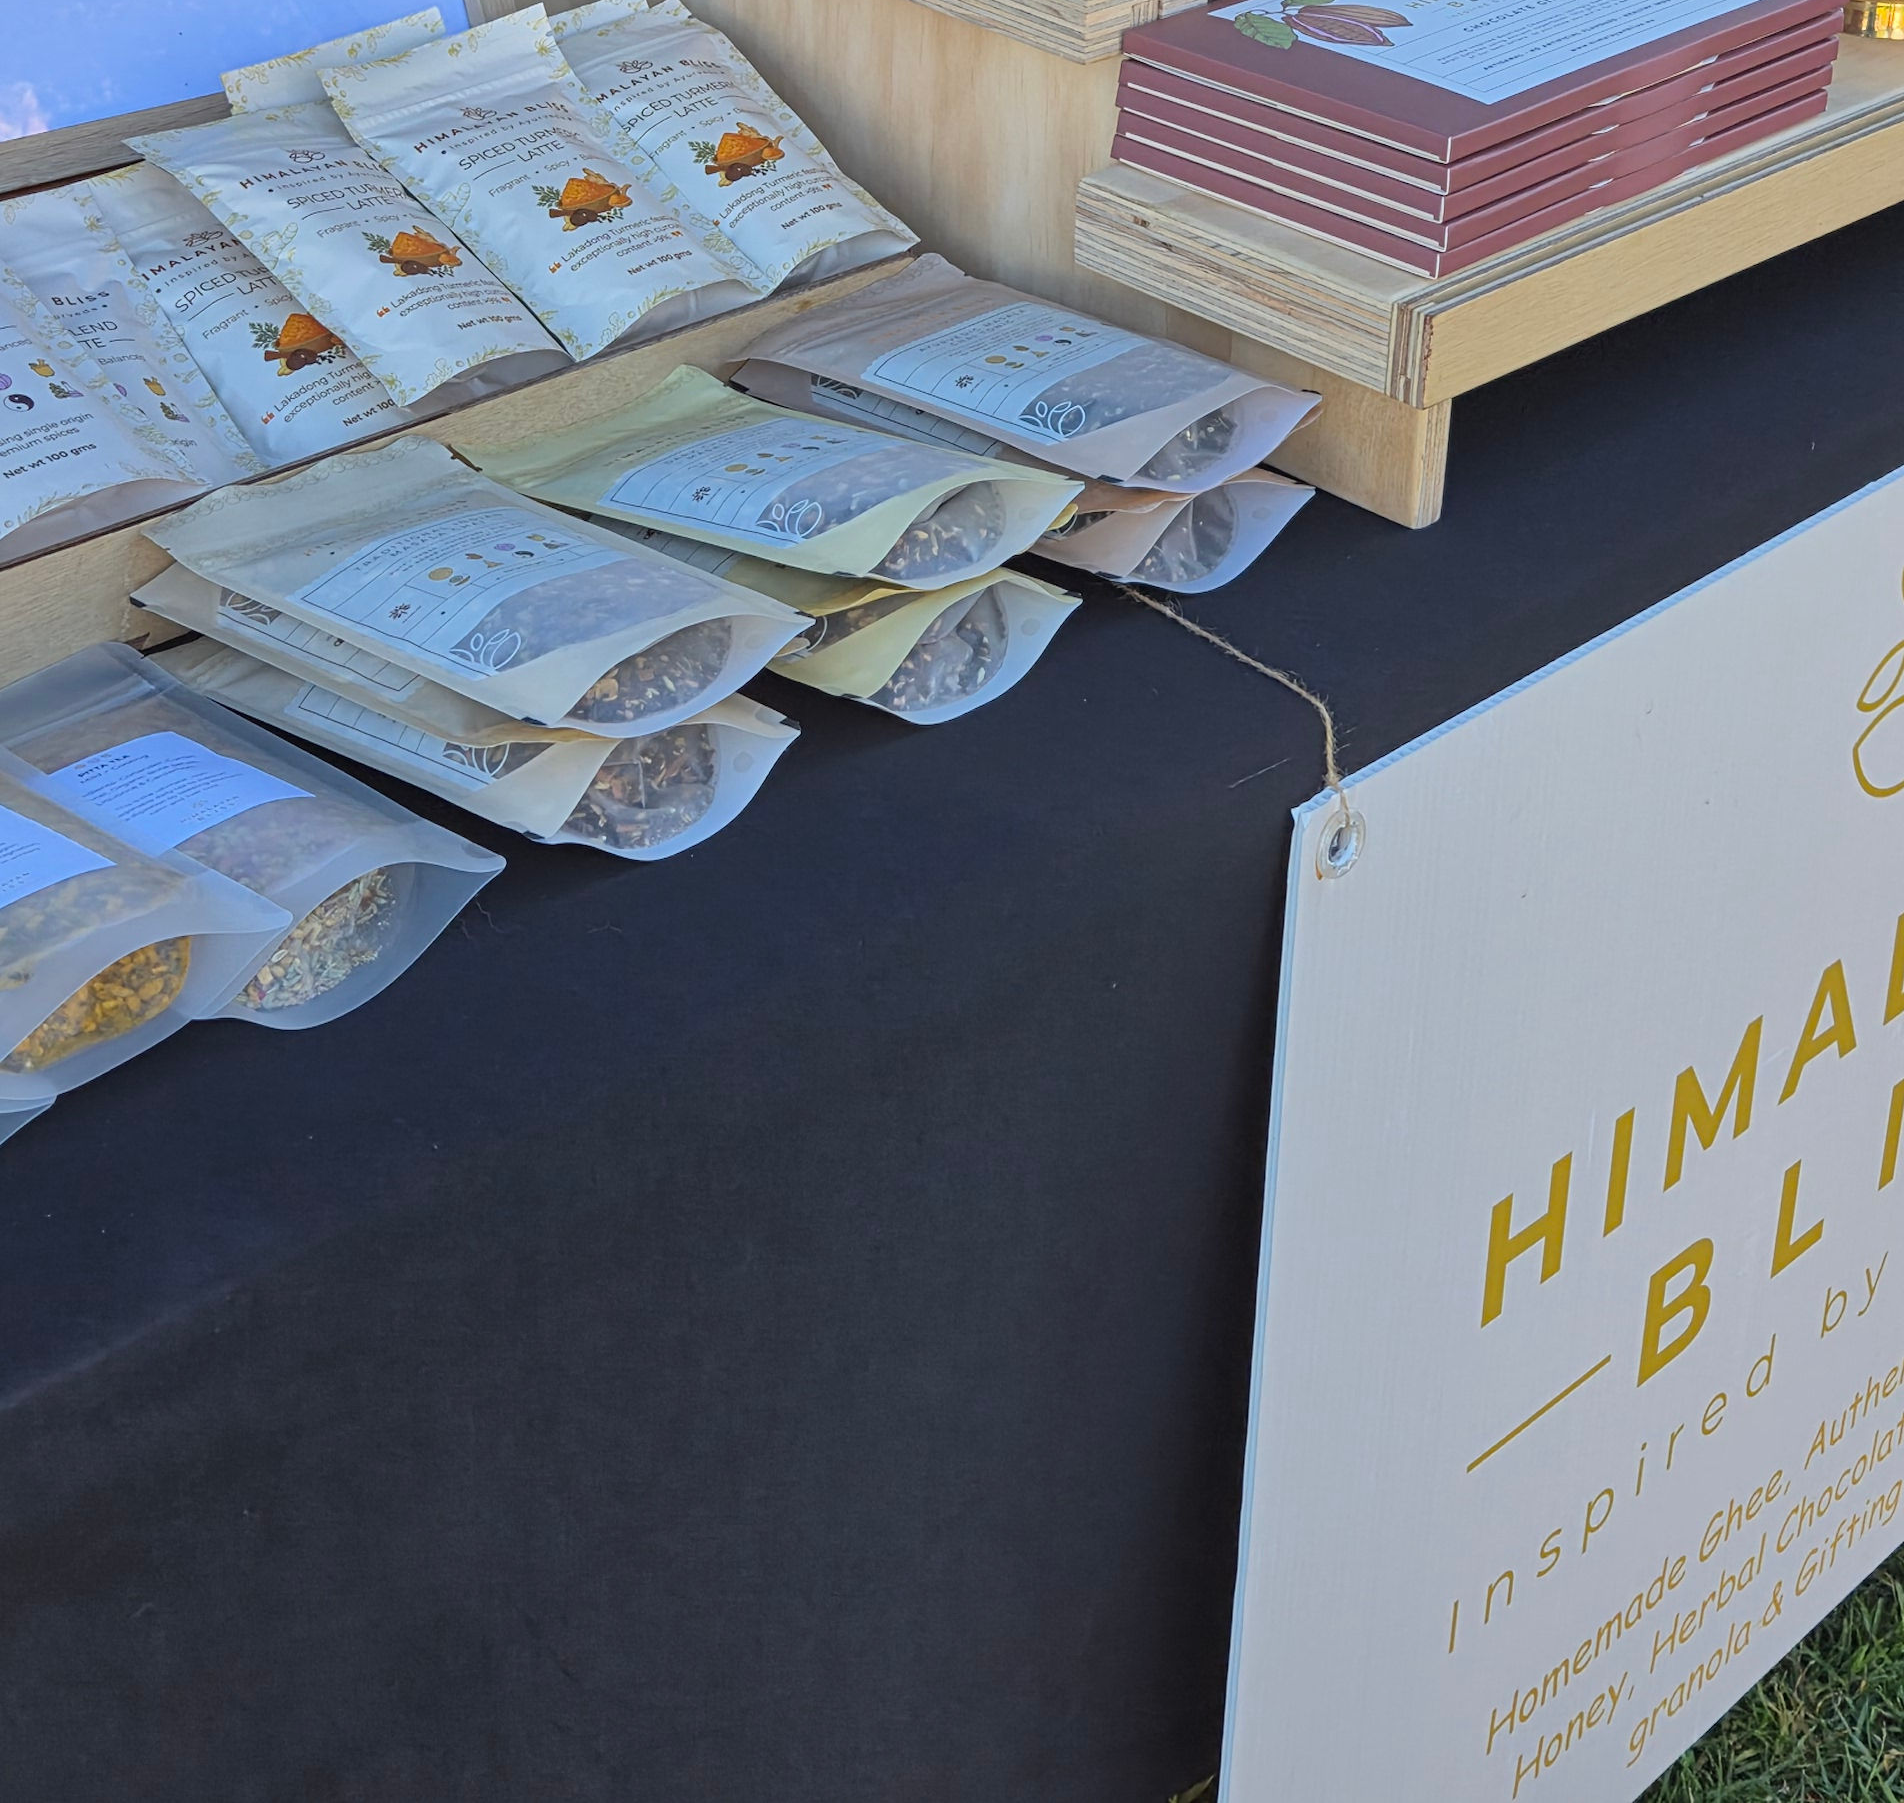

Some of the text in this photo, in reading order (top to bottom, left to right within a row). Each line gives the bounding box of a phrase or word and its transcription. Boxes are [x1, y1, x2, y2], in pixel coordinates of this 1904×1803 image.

[1463, 2, 1536, 33] CHOCOLATE
[622, 97, 673, 134] SPICED
[673, 96, 719, 118] LATTE
[414, 110, 520, 154] HIMALAYAN
[516, 140, 565, 163] LATTE
[458, 140, 516, 172] SPICED
[488, 158, 570, 198] Fragrant Spicy
[286, 187, 345, 210] SPICED
[561, 217, 652, 263] Lakadong Turmeric
[570, 227, 653, 273] exceptionally high
[616, 239, 654, 258] content
[1448, 1333, 1776, 1657] Inspired
[1819, 1250, 1888, 1339] by
[1486, 1554, 1686, 1756] Homemade
[1699, 1468, 1792, 1563] Ghee,
[1627, 1617, 1751, 1768] granola
[1761, 1580, 1784, 1624] &
[1794, 1474, 1901, 1597] Gifting
[1512, 1670, 1635, 1801] Honey,
[1649, 1531, 1767, 1674] Herbal
